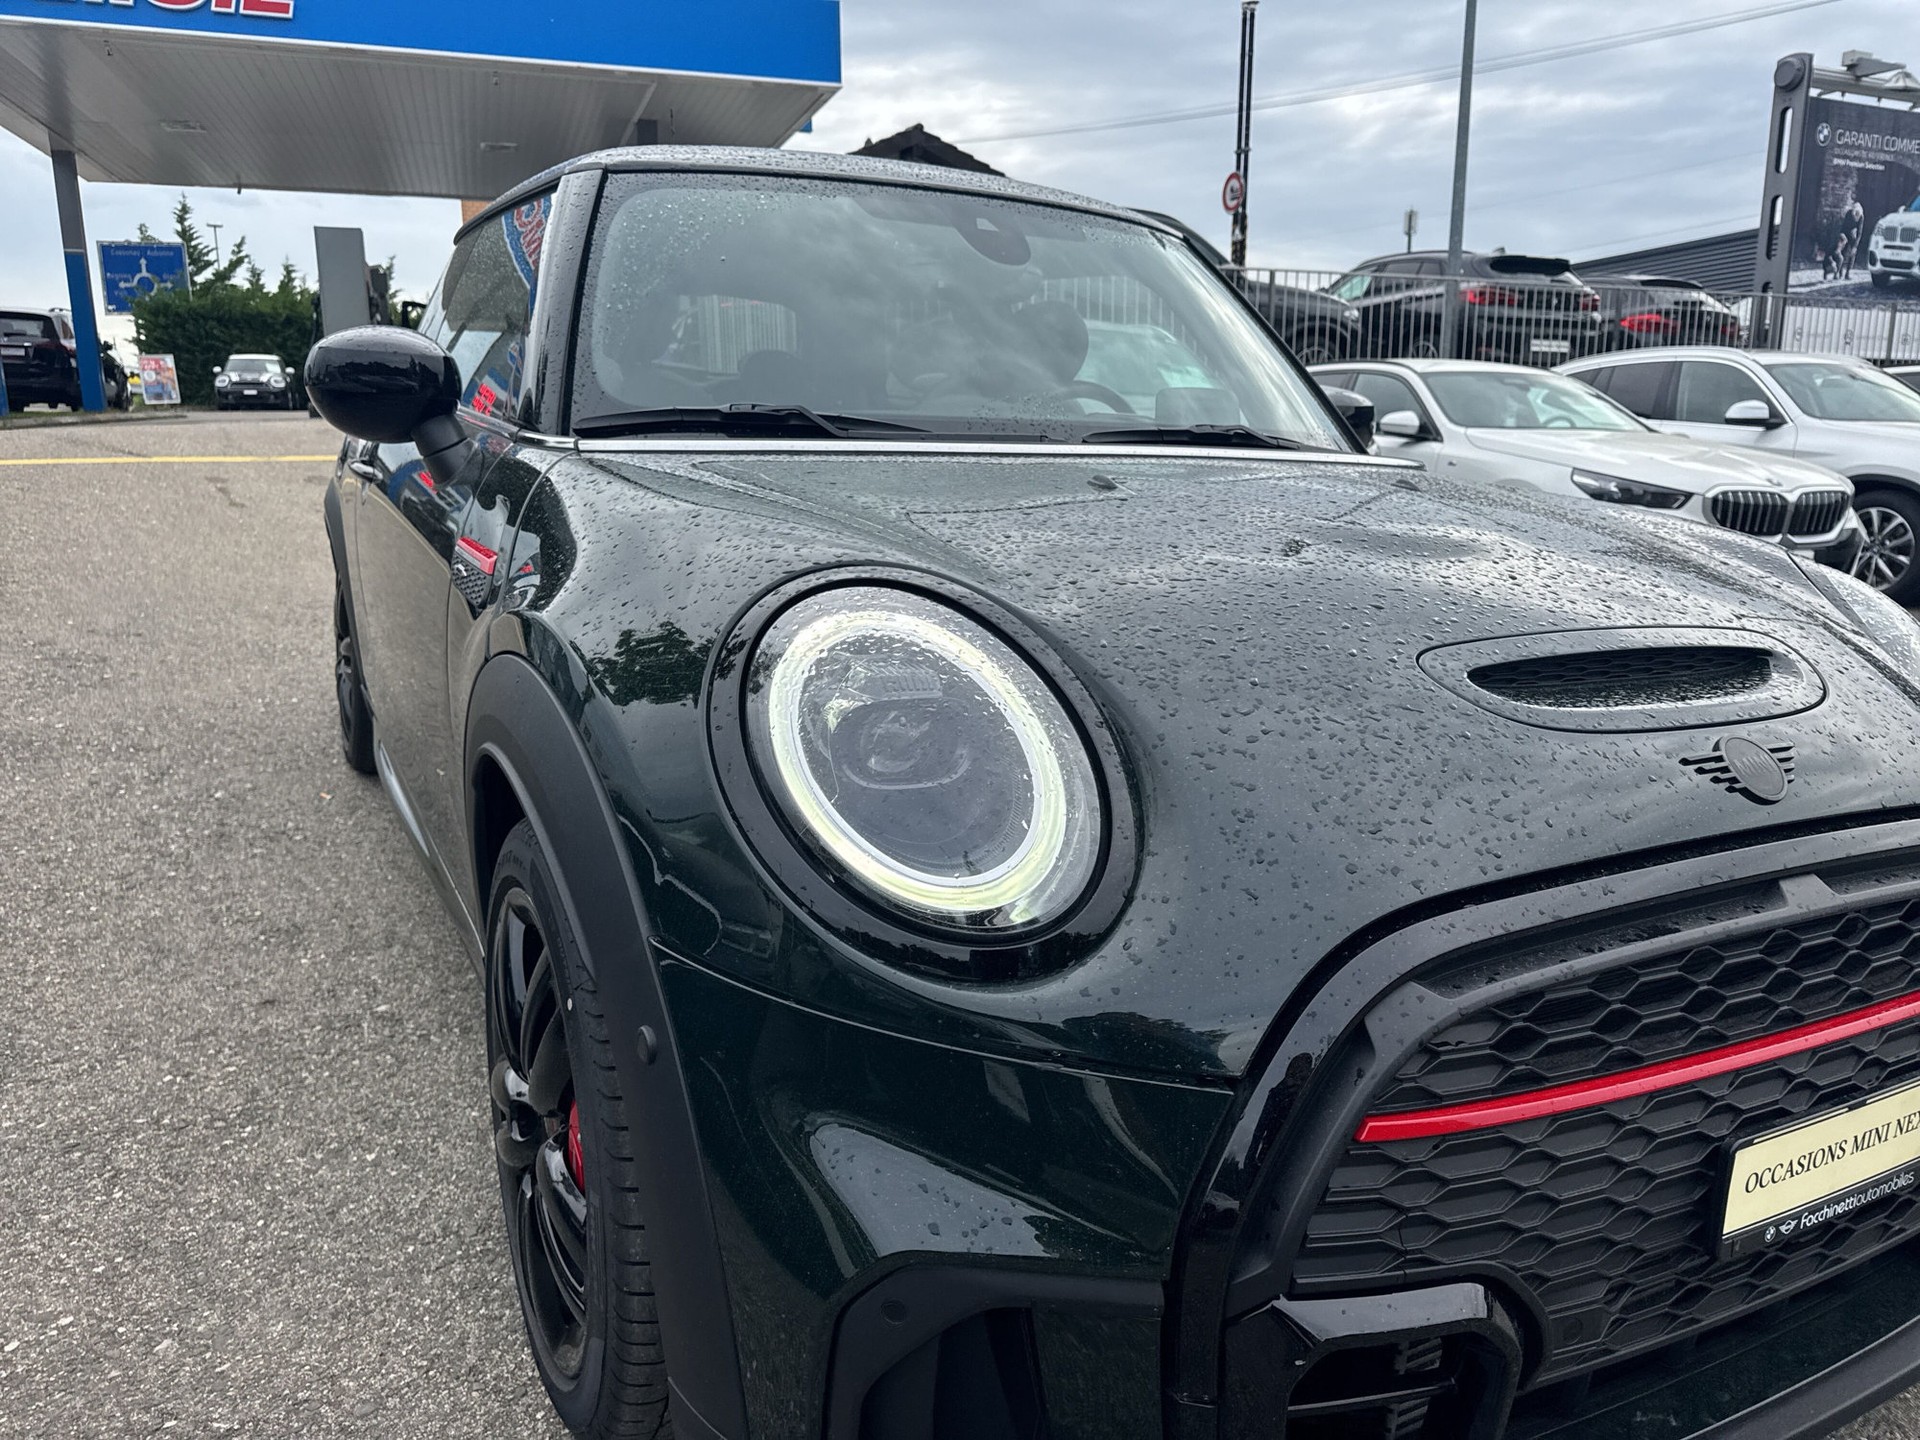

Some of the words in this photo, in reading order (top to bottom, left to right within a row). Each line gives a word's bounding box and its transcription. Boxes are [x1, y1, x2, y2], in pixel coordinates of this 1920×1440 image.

[1836, 129, 1882, 149] GARANTI
[1883, 135, 1920, 153] COMME
[1744, 1139, 1847, 1194] OCCASIONS
[1850, 1121, 1892, 1156] MINI
